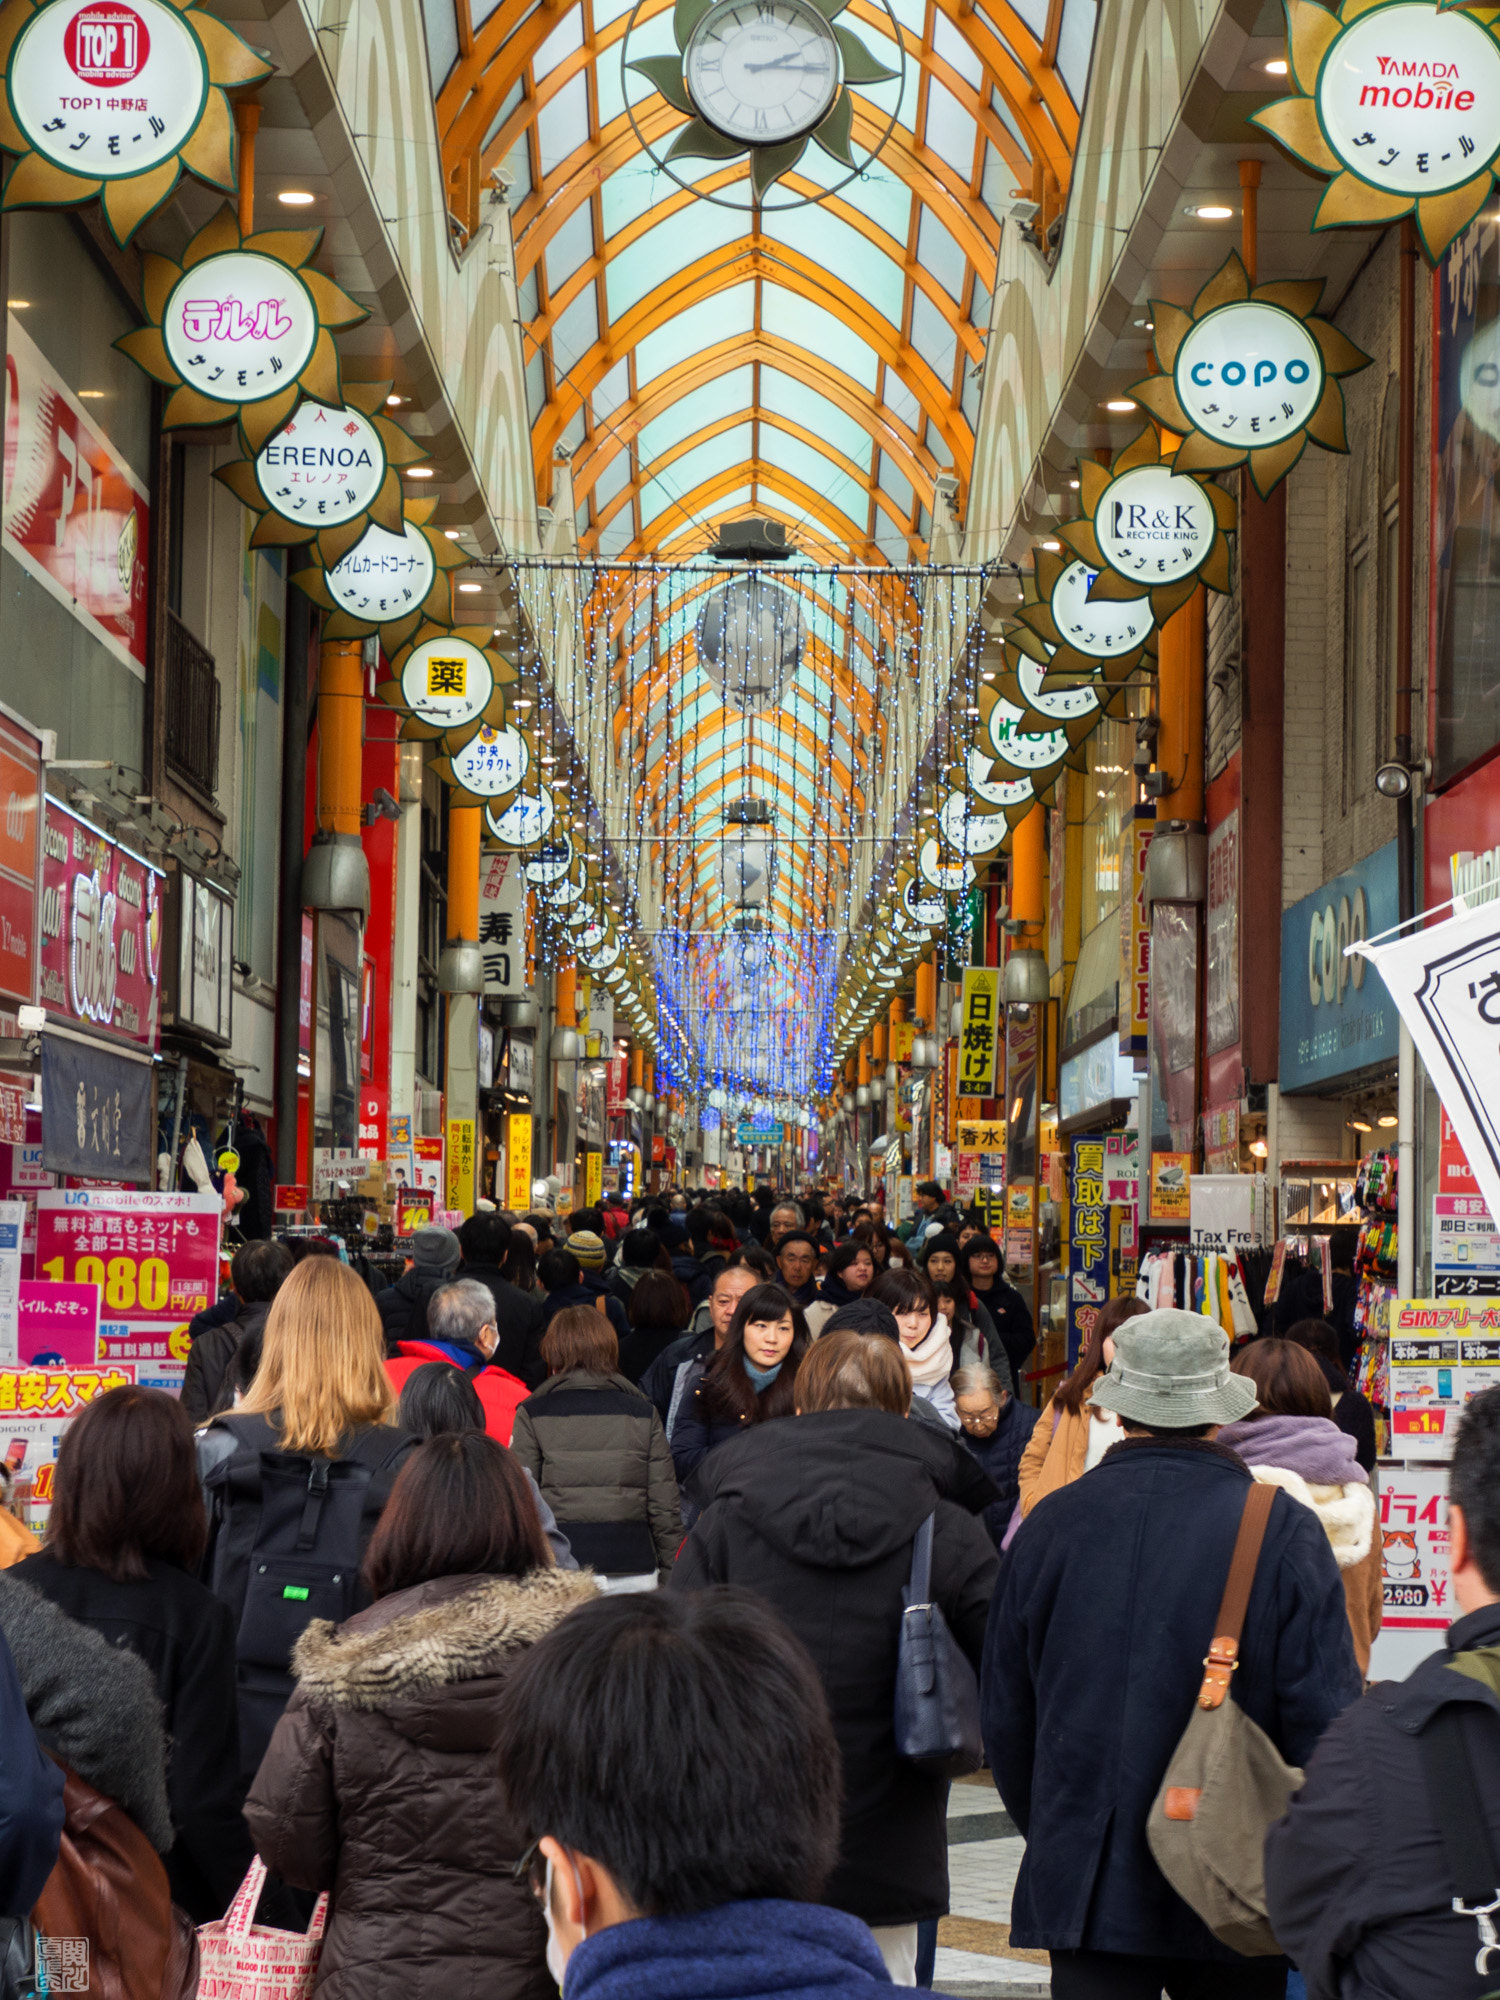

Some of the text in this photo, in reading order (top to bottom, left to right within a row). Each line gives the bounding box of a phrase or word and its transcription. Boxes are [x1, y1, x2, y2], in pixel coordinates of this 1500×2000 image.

[81, 25, 133, 67] TOP 1
[1376, 56, 1459, 78] YAMADA
[59, 97, 148, 112] TOP1 中野店
[1359, 81, 1475, 111] mobile
[42, 116, 166, 156] サンモール
[1352, 131, 1475, 173] サンモール
[182, 298, 293, 343] テルル
[188, 354, 283, 386] サンモール
[1202, 402, 1295, 433] サンモール
[265, 446, 373, 468] ERENOA
[290, 472, 348, 484] エレノア
[275, 486, 357, 514] サンモール
[1128, 503, 1197, 530] R&K
[1126, 531, 1199, 541] RECYCLE KING
[1117, 546, 1194, 573] サンモール
[342, 588, 413, 611] サンモール
[1069, 624, 1138, 648] サンモール
[430, 660, 463, 693] 薬
[477, 744, 499, 757] 中央
[466, 758, 513, 772] コンタクト
[479, 911, 513, 987] 寿司
[963, 992, 993, 1079] 日焼け
[461, 1123, 472, 1176] 自転車から
[513, 1167, 527, 1198] 禁止
[65, 1191, 89, 1206] UQ
[1076, 1143, 1107, 1268] 買取は下
[53, 1216, 200, 1236] 無料通話もネットも
[1194, 1229, 1262, 1244] Tax Free
[74, 1235, 177, 1253] 全部コミコミ!
[1399, 1308, 1500, 1329] SIMフリー大
[109, 1342, 167, 1358] 無料通話
[1464, 1346, 1500, 1359] 本体一
[1379, 1486, 1451, 1525] プライ
[236, 1961, 259, 1973] BLOOD
